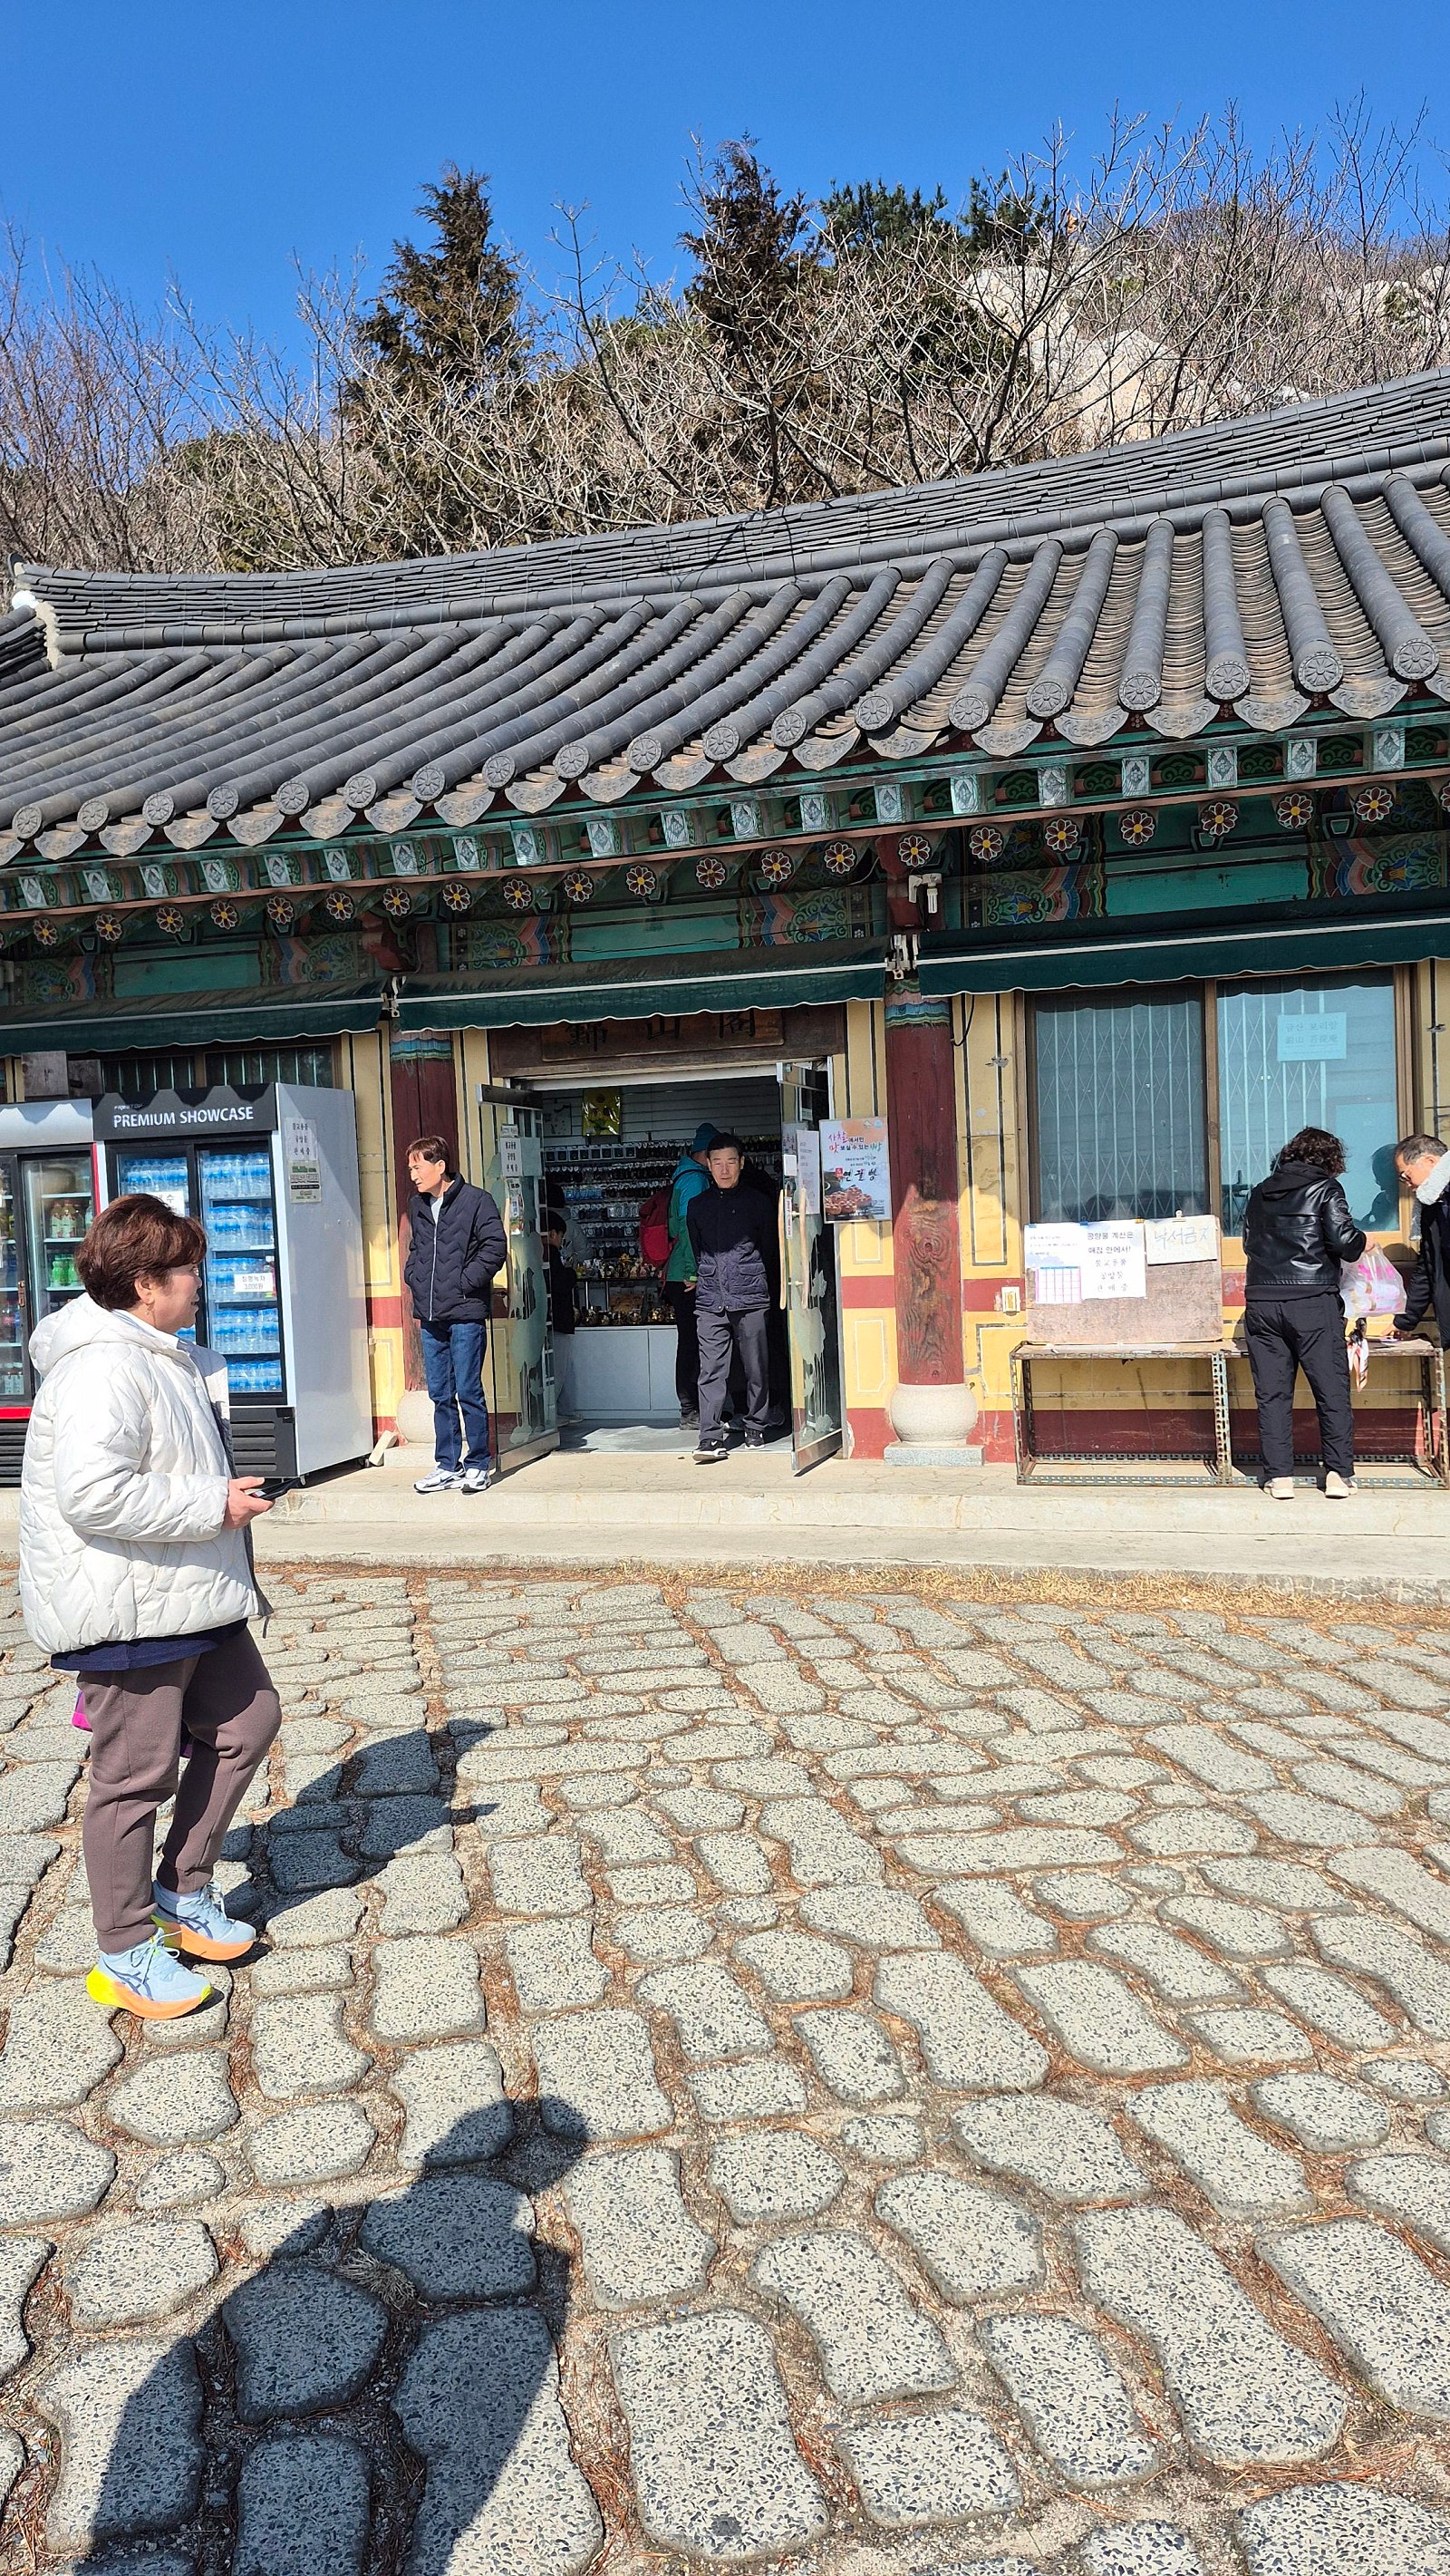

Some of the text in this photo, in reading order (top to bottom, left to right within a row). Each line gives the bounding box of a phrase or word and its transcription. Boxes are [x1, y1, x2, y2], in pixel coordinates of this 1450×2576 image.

[113, 1106, 254, 1128] PREMIUM SHOWCASE
[1087, 1231, 1135, 1241] 공양물 계산은
[1088, 1246, 1103, 1254] 매점
